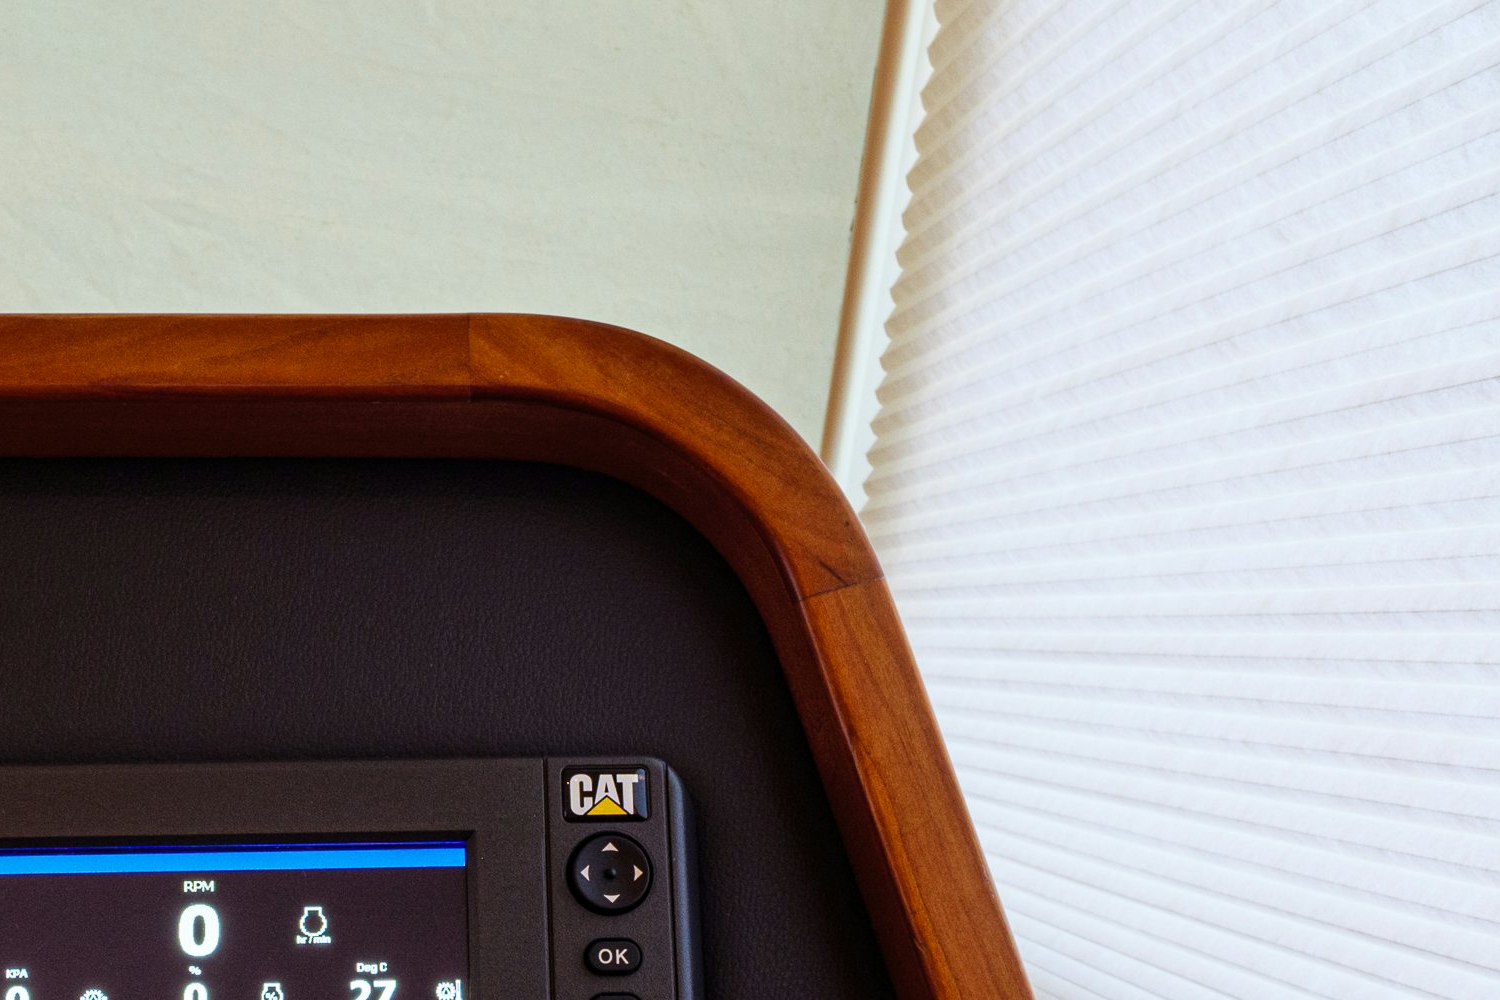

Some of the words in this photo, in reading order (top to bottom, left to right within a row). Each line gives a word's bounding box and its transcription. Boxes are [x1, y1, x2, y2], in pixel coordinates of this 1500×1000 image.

[569, 773, 639, 816] CAT
[183, 880, 215, 893] RPM
[178, 903, 221, 957] 0
[598, 948, 629, 965] OK
[5, 968, 29, 980] KPA
[188, 965, 202, 976] %
[356, 962, 377, 975] Deg
[378, 961, 388, 974] C
